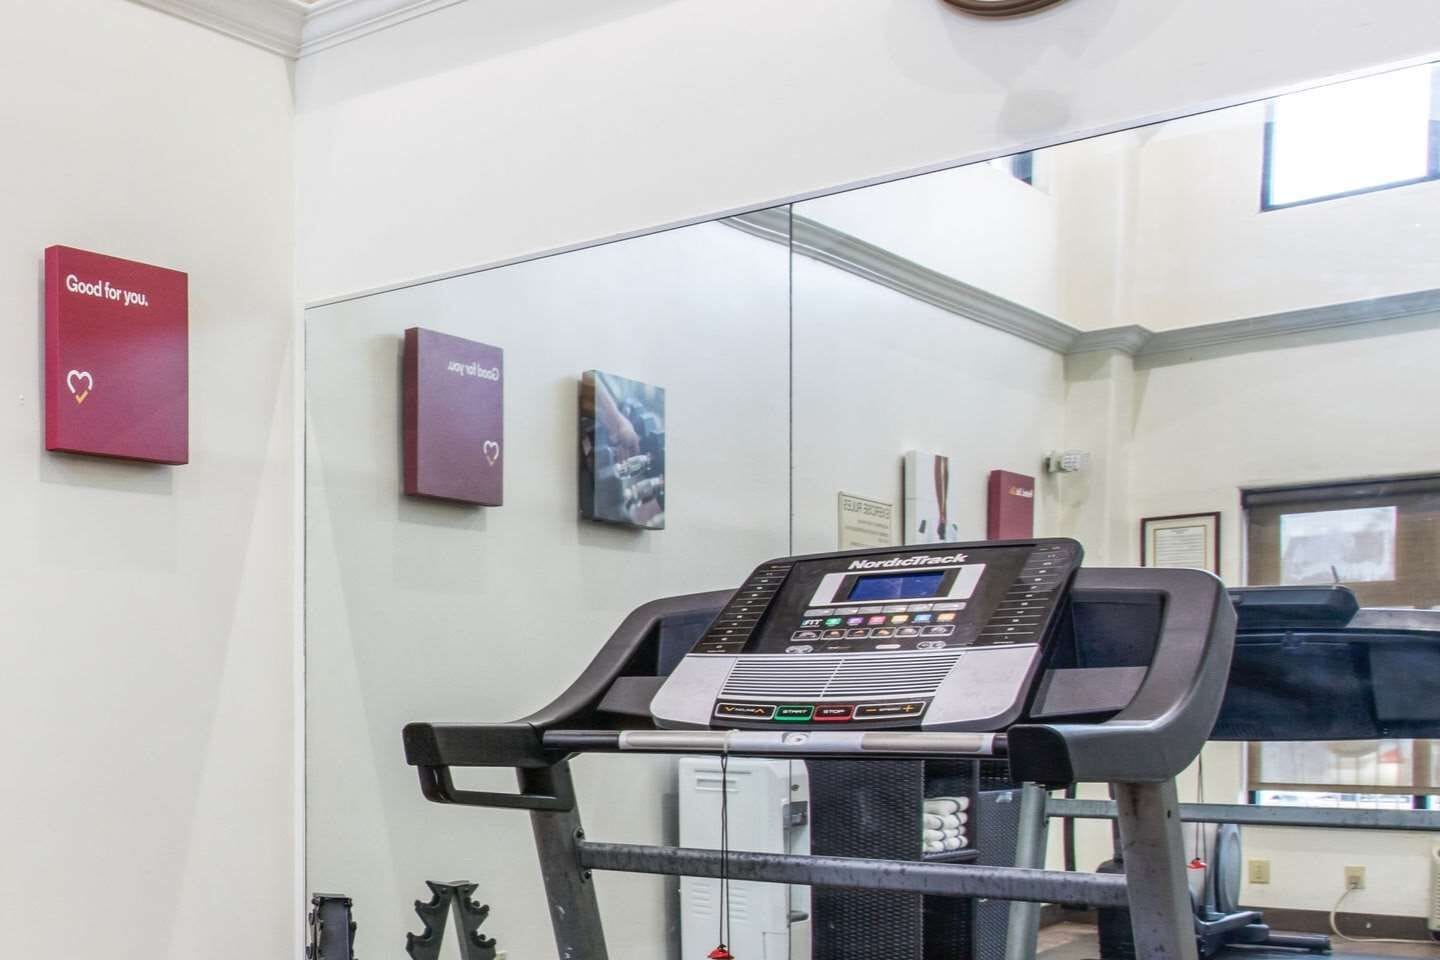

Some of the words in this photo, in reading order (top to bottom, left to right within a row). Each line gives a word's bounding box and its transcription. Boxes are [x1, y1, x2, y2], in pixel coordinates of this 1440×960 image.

[66, 274, 102, 296] Good
[105, 282, 121, 300] for
[124, 290, 149, 306] you.
[848, 553, 968, 570] NordicTrack
